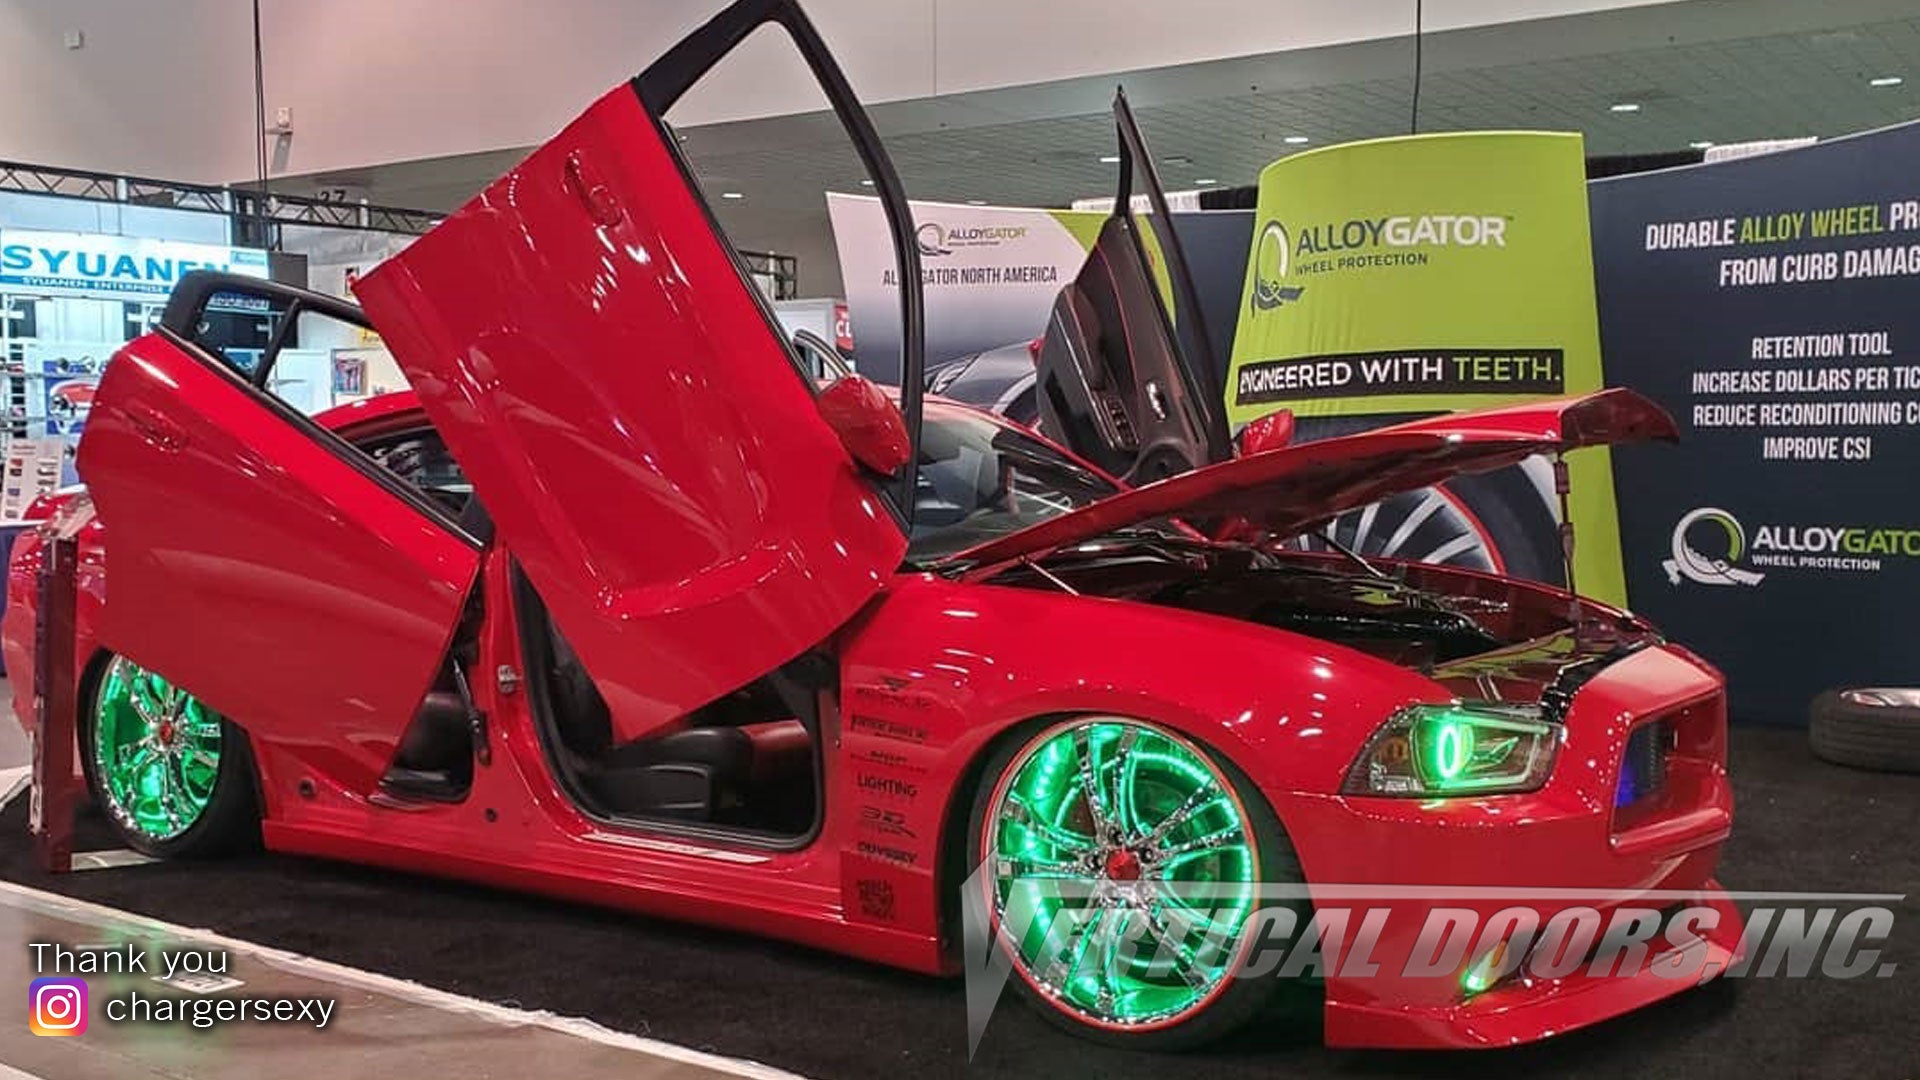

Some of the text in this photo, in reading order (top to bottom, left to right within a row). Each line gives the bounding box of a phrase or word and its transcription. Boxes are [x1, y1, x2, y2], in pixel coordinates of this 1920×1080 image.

[948, 225, 1026, 240] ALLOYGATOR
[1645, 200, 1920, 251] DURABLE ALLOY WHEEL PR
[883, 264, 1058, 286] ALGATOR NORTH AMERICA
[1295, 252, 1428, 275] WHEEL PROTECTION
[1719, 245, 1920, 287] FROM CURB DAMAG
[1751, 331, 1892, 360] RETENTION TOOL
[1360, 356, 1443, 384] WITH
[1452, 356, 1562, 382] TEETH.
[1692, 370, 1772, 394] INCREASE
[1775, 368, 1851, 392] DOLLARS
[1855, 367, 1889, 390] PER
[1692, 400, 1920, 427] REDUCE RECONDITIONING C
[1763, 436, 1871, 460] IMPROVE CSI
[1751, 554, 1881, 571] WHEEL PROTECTION
[856, 772, 918, 798] LIGHTING
